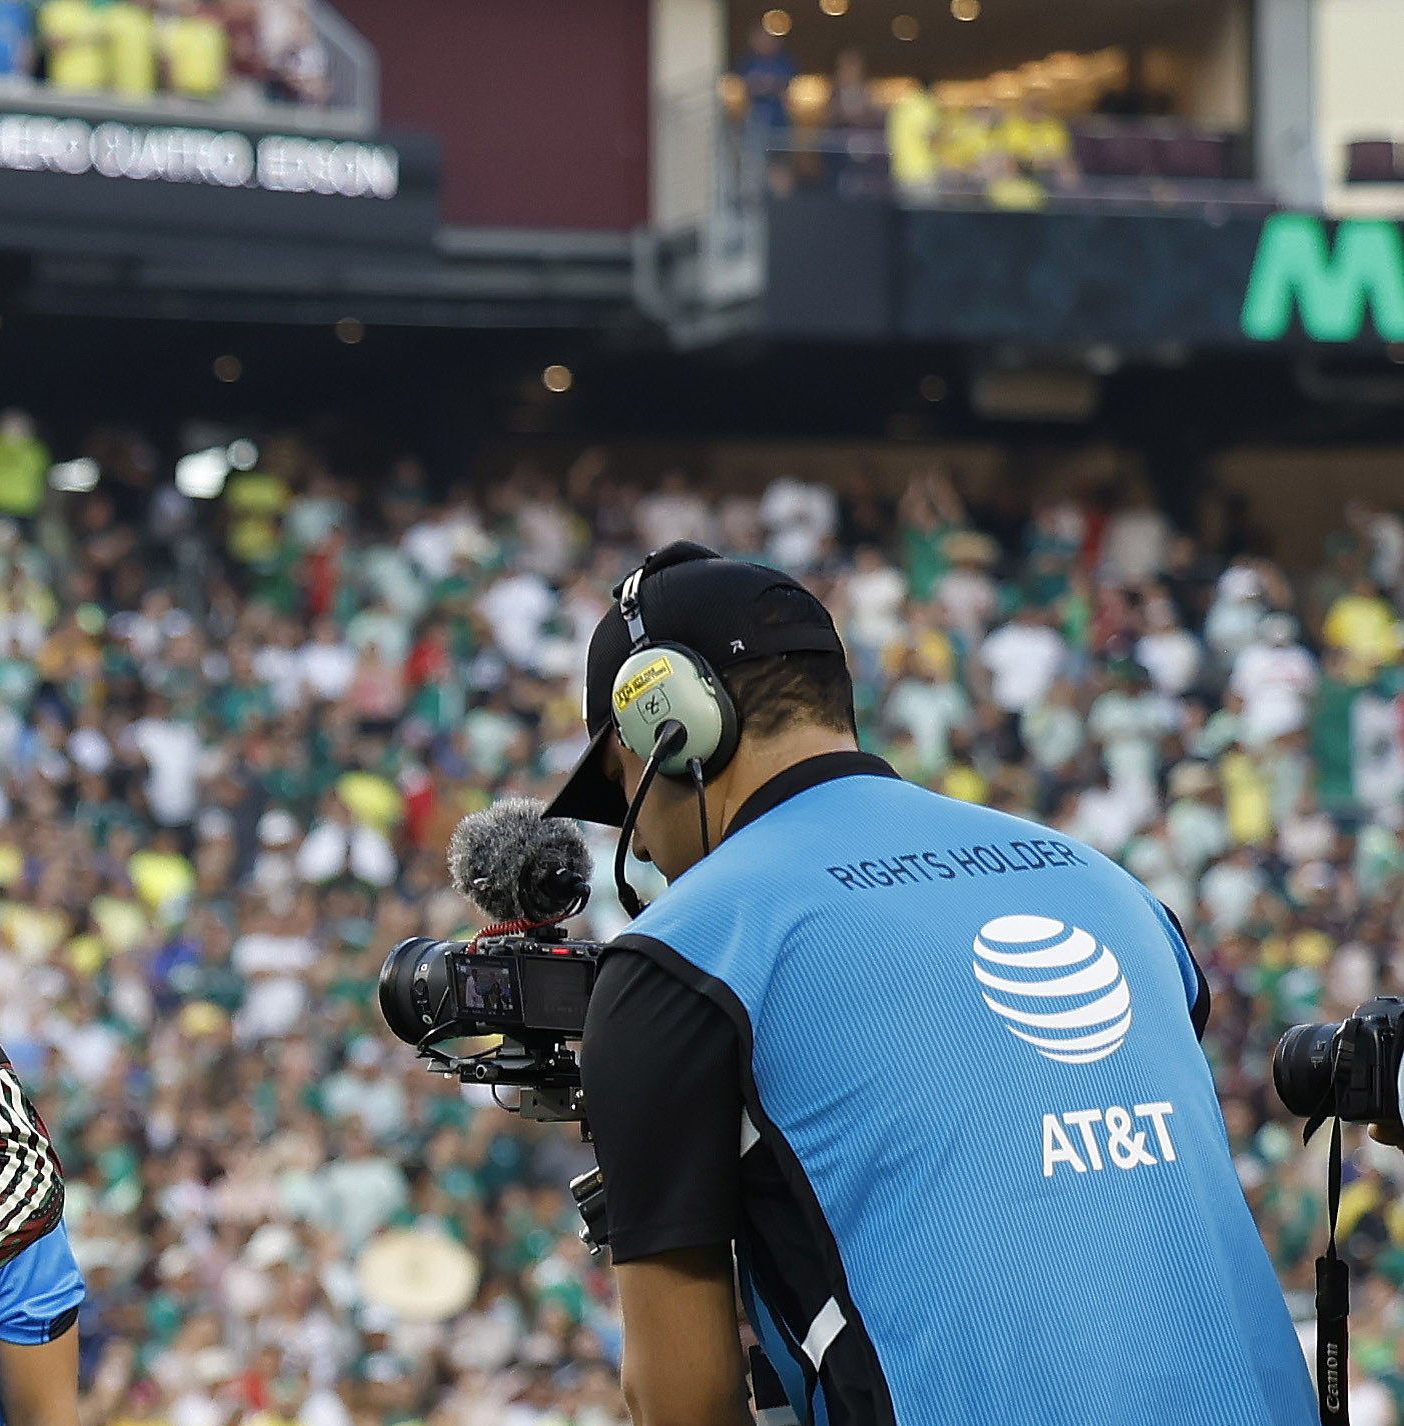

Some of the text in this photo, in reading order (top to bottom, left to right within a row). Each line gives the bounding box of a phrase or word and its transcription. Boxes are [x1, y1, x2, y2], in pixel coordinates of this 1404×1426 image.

[826, 838, 1089, 891] RIGHTS HOLDER
[1041, 1101, 1176, 1178] AT&T
[1326, 1342, 1340, 1414] Canon
